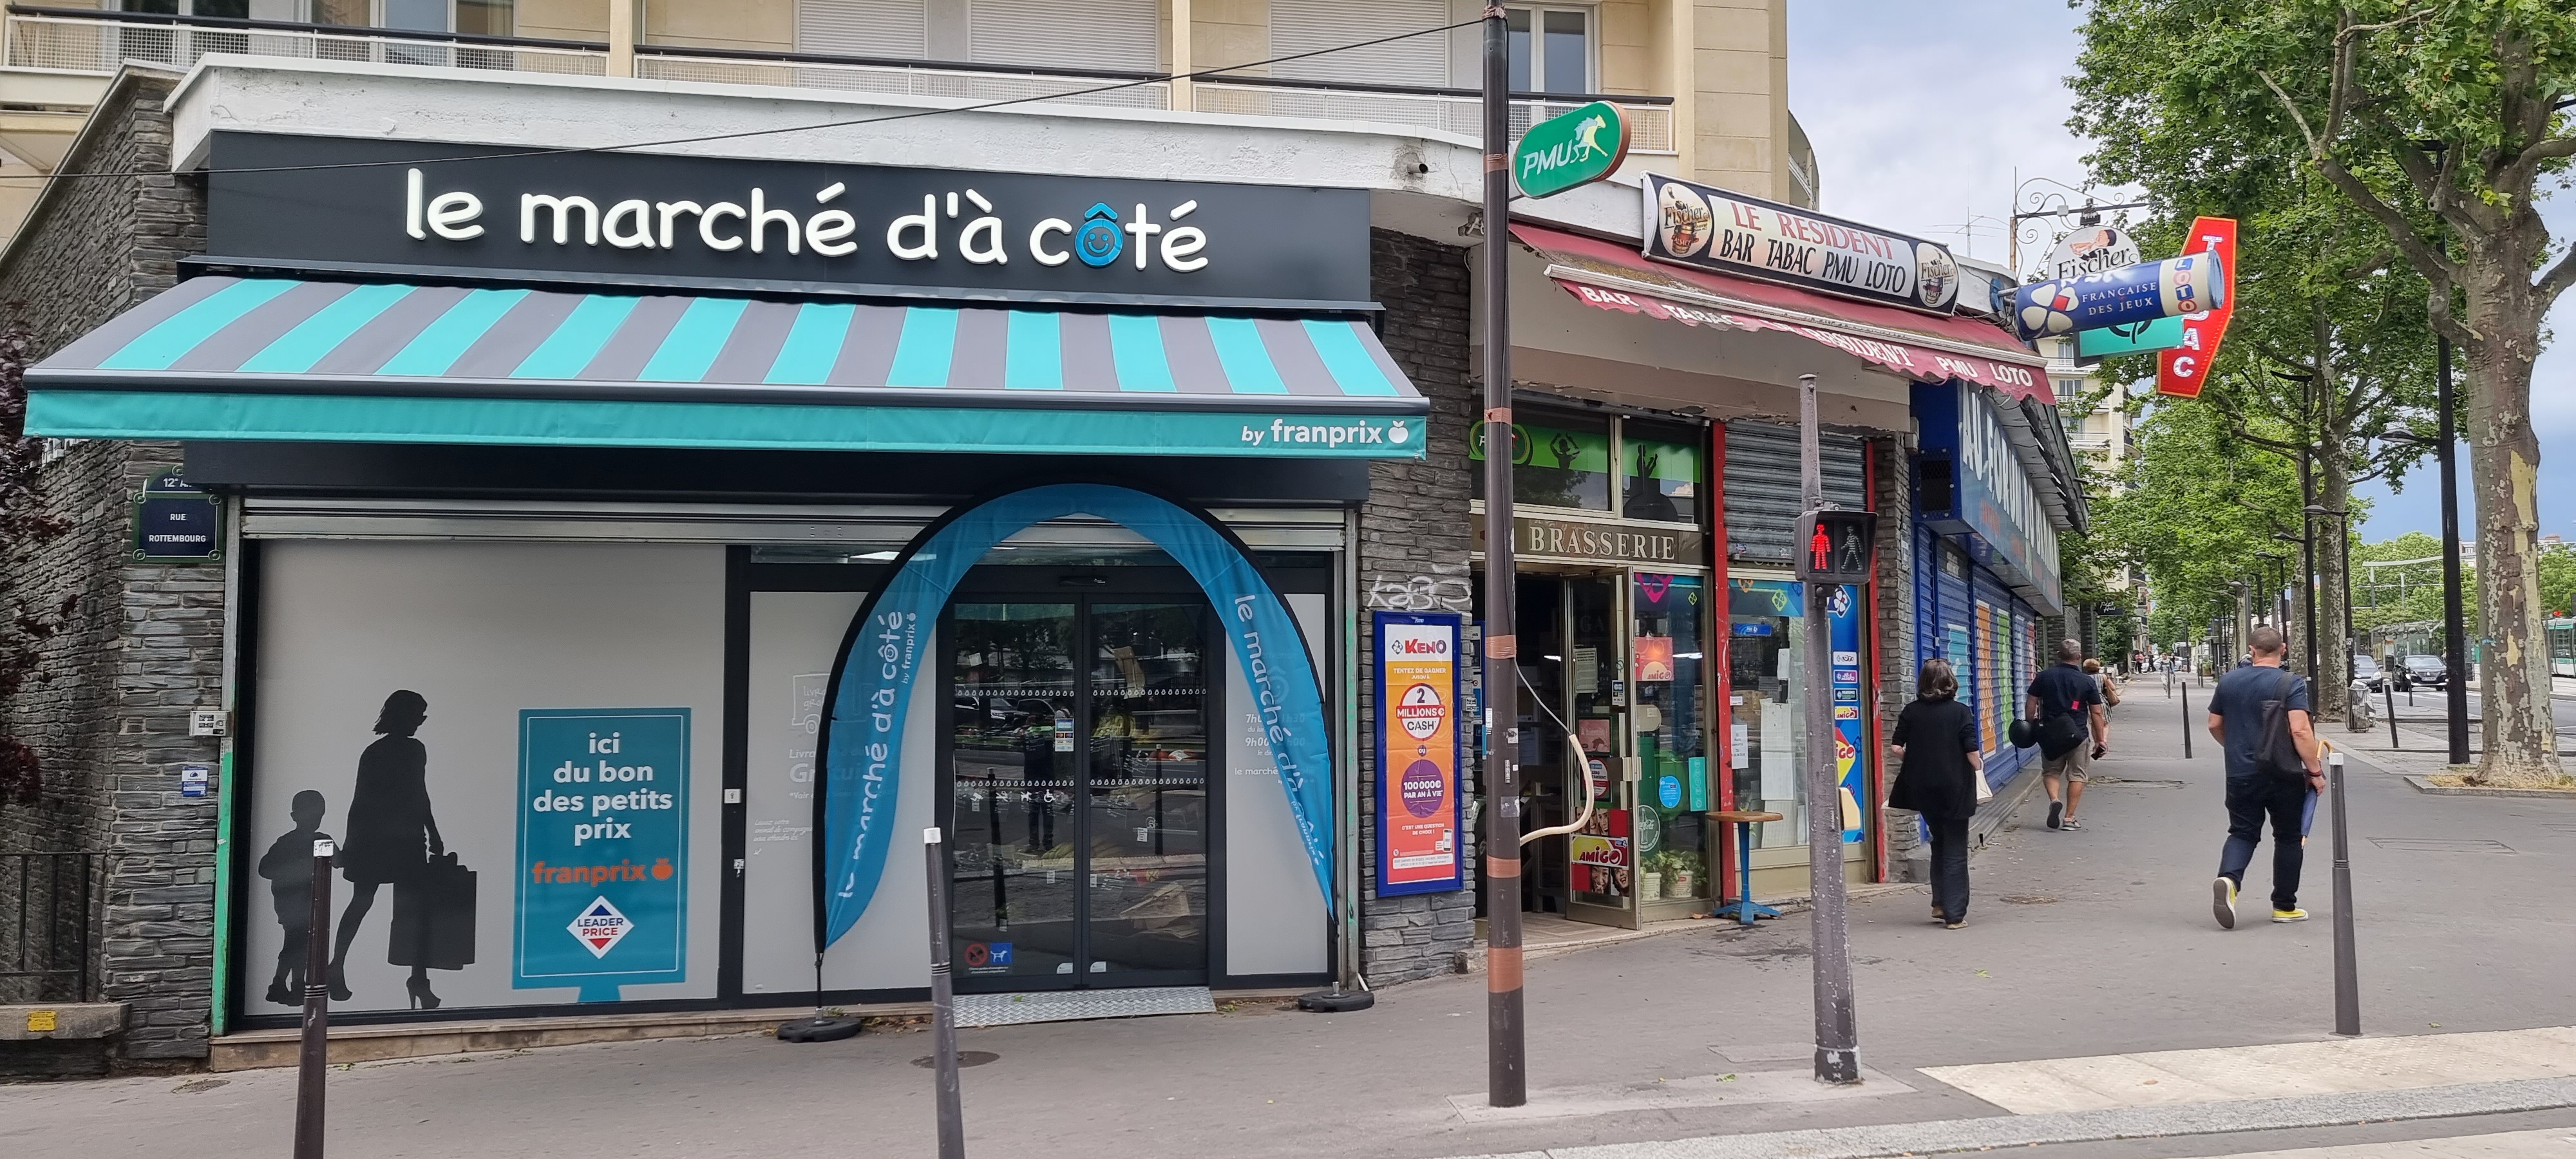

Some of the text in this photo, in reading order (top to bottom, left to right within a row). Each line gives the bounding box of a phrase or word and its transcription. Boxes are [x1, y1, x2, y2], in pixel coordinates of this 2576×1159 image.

[1523, 139, 1573, 180] PMU
[406, 167, 1209, 272] le marché d'à côté
[1730, 202, 1893, 260] LE RESIDENT
[1719, 229, 1906, 293] BAR TABAC PMU LOTO
[2057, 248, 2130, 279] Fischer
[2174, 258, 2197, 313] LOTO
[2088, 297, 2154, 316] DES JEUX
[1578, 286, 1640, 308] BAR
[1661, 304, 1745, 326] TABAC
[1934, 355, 1979, 379] PMU
[1989, 363, 2034, 388] LOTO
[1242, 419, 1383, 448] by franprix
[1530, 525, 1674, 560] BRASSERIE
[1235, 594, 1255, 621] le
[901, 624, 916, 684] by franprix
[1405, 638, 1446, 654] KENO
[1244, 631, 1292, 744] marché
[1417, 688, 1425, 703] 2
[589, 731, 620, 754] ici
[553, 760, 653, 783] du bon
[1245, 766, 1279, 775] marché
[533, 787, 673, 817] des petits
[574, 818, 632, 845] prix
[531, 859, 647, 887] franprix
[578, 917, 624, 927] LEADER
[582, 927, 618, 938] PRICE
